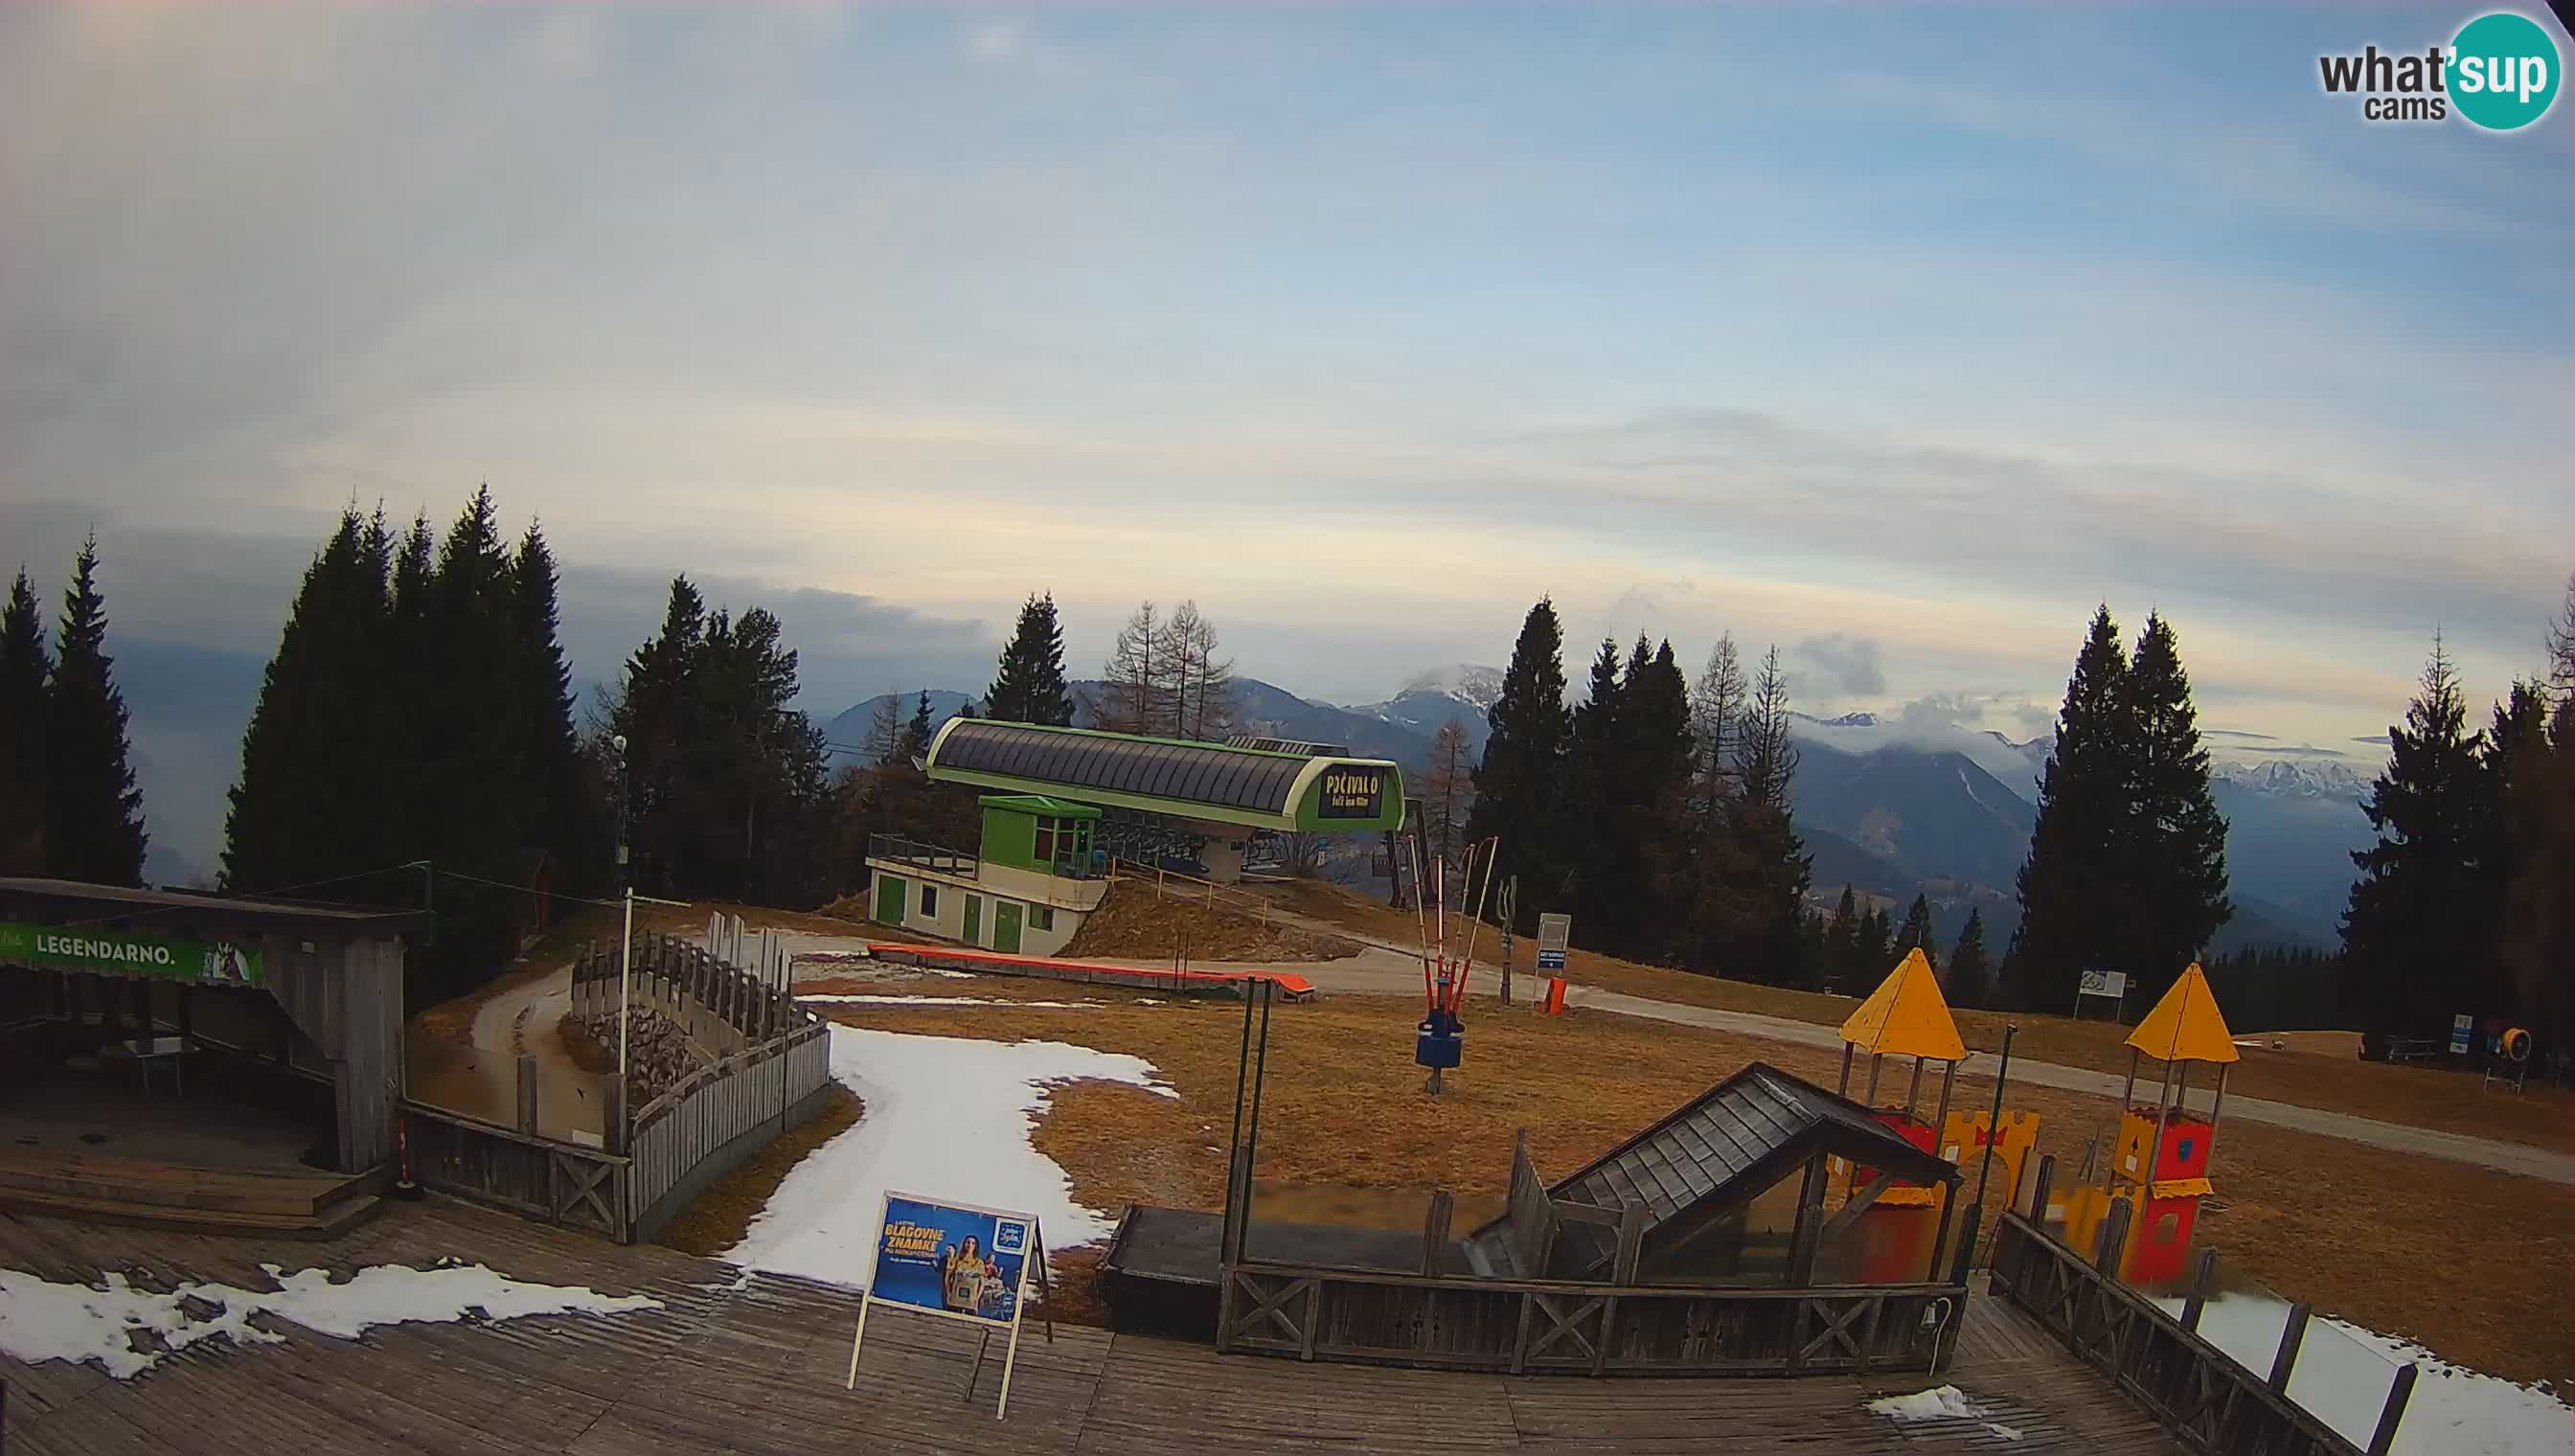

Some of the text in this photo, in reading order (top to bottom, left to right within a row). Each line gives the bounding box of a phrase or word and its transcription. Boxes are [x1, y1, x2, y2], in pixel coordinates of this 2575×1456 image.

[36, 934, 176, 966] LEGENDARNO.
[885, 1223, 946, 1241] BLAGOVNE
[887, 1236, 938, 1252] ZNAMKE
